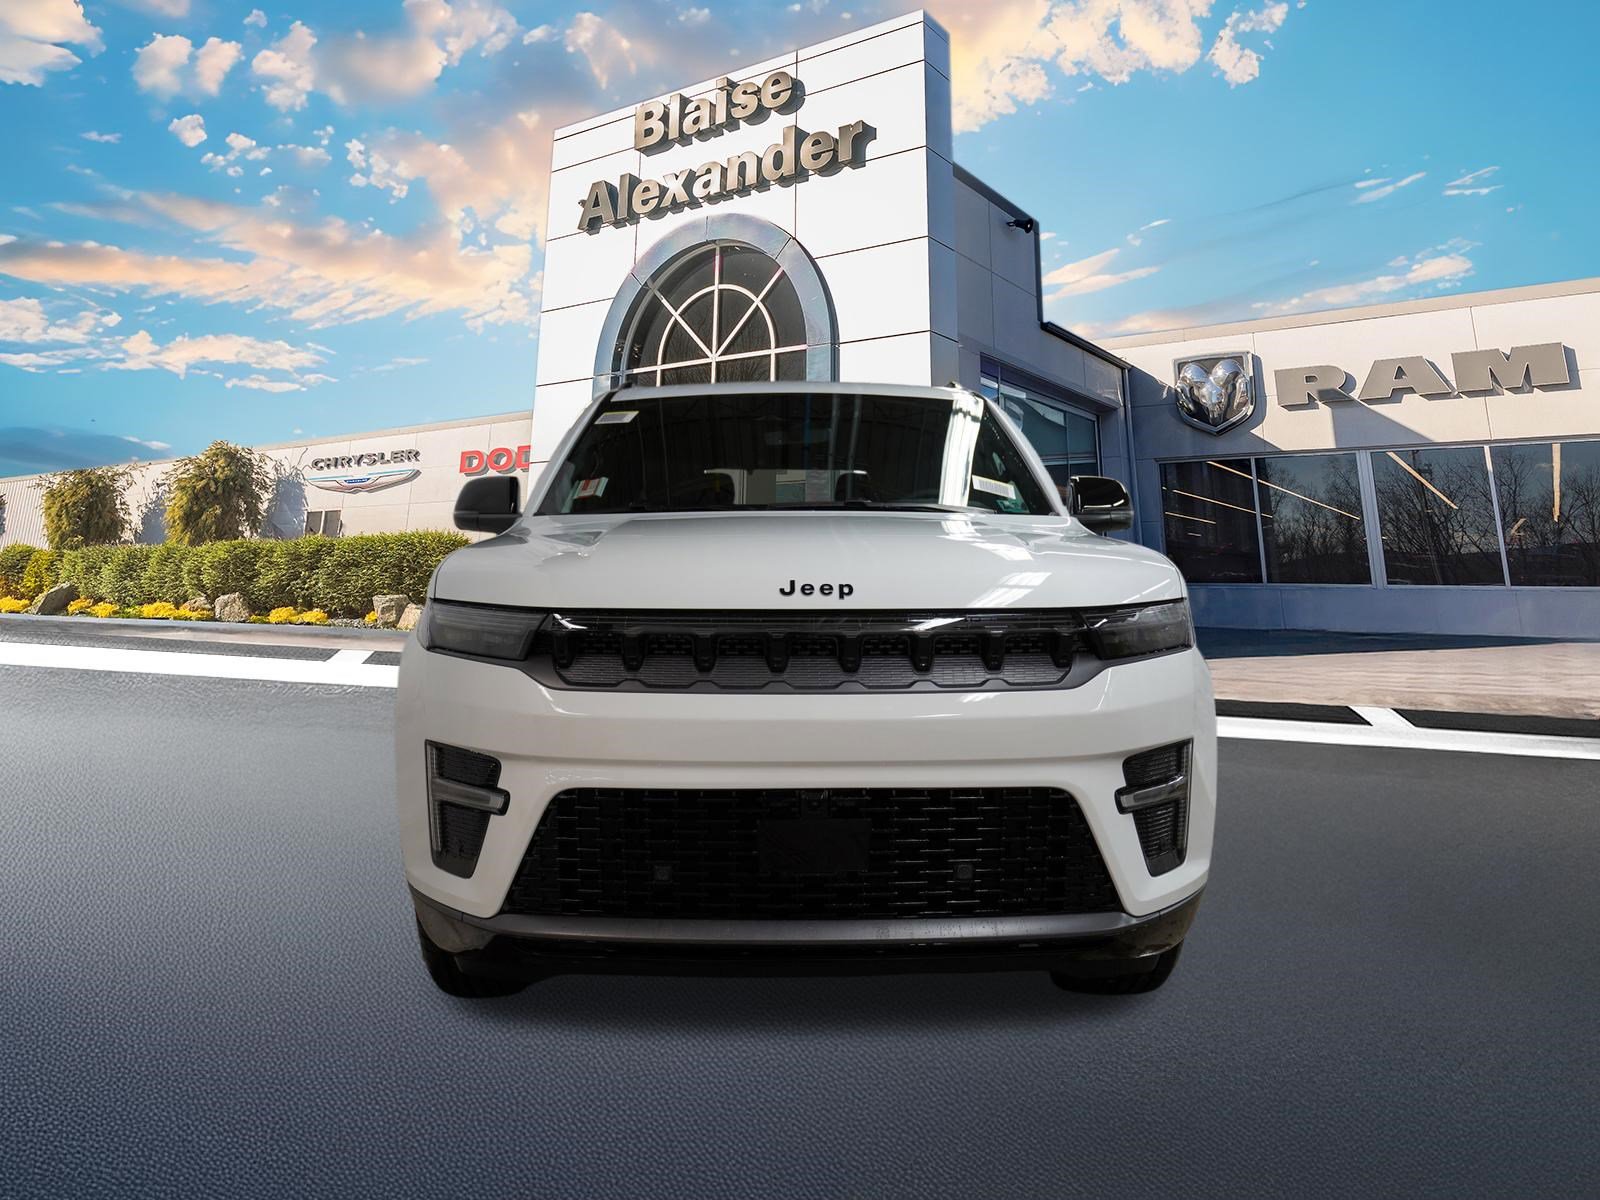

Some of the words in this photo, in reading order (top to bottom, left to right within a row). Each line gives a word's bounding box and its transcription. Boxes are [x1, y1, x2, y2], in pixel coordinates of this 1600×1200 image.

[635, 71, 796, 152] Blaise
[578, 120, 867, 232] Alexander
[1274, 342, 1572, 406] RAM
[312, 449, 419, 470] CHRYSLER
[779, 579, 854, 600] Jeep
